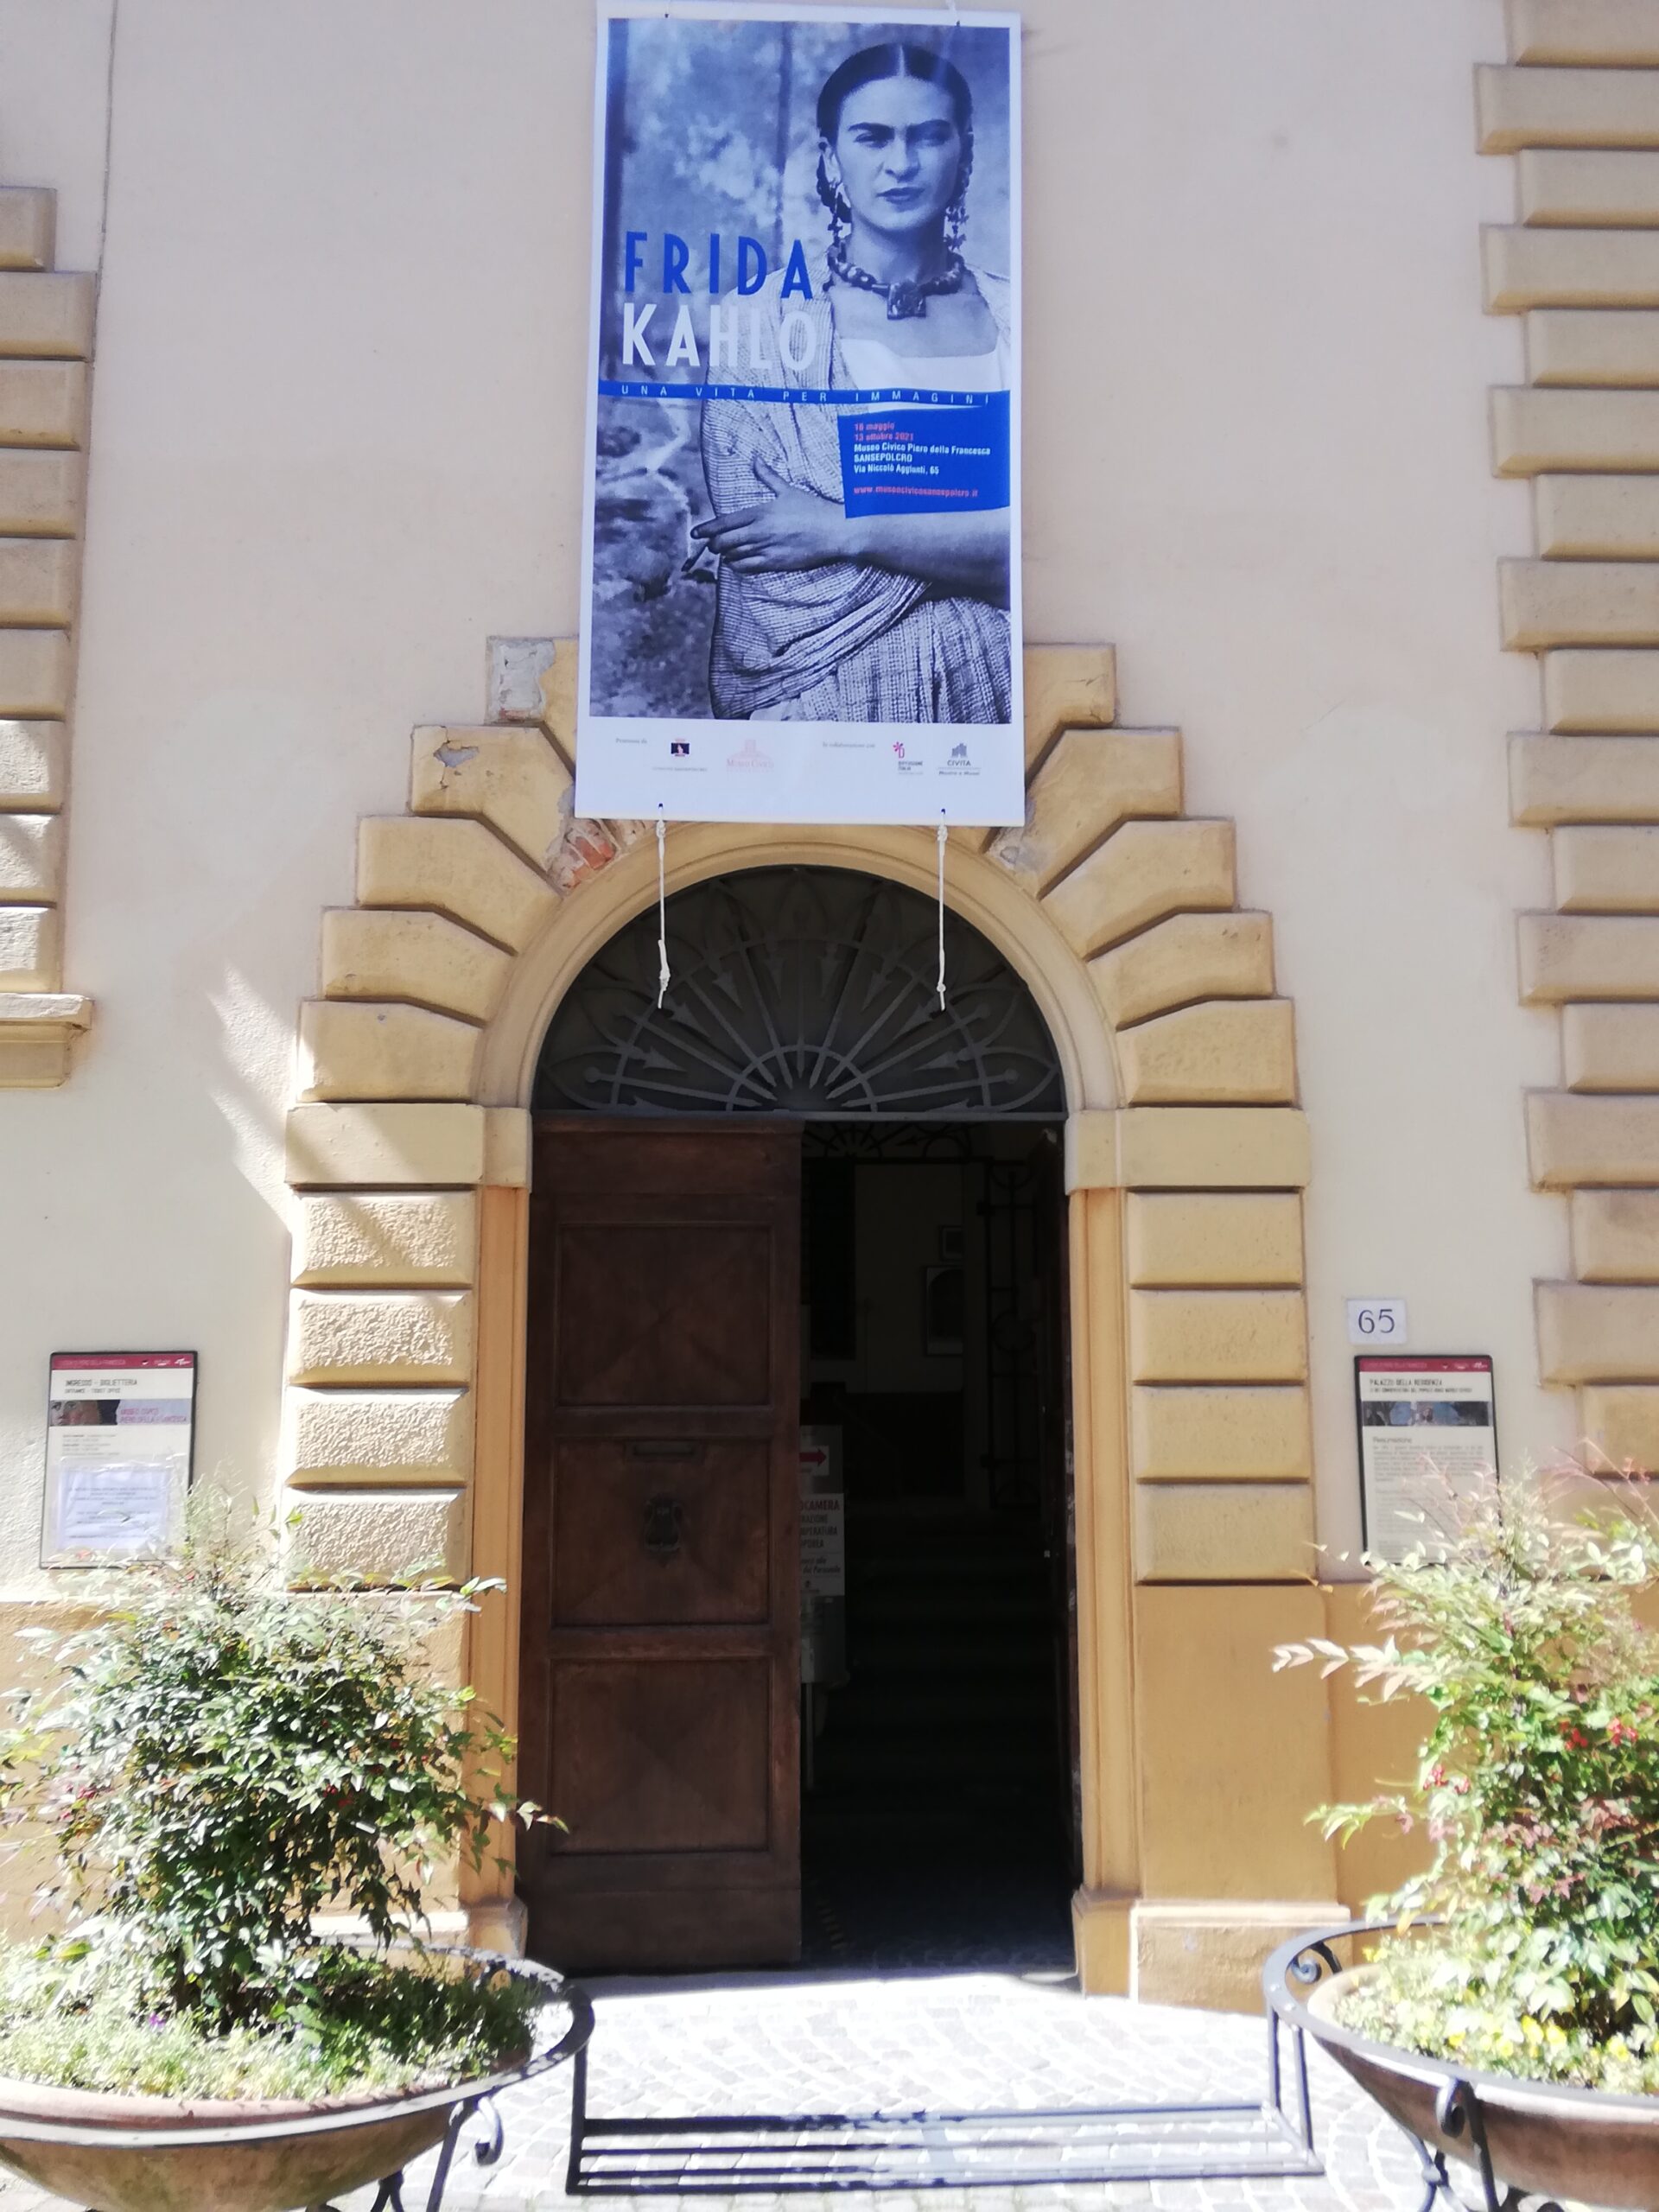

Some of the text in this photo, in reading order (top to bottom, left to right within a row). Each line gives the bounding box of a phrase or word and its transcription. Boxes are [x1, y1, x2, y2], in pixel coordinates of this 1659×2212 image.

[625, 231, 813, 300] FRIDA
[622, 302, 817, 372] KAHLO
[621, 385, 988, 404] UNA VITA PER IMMAGINI
[866, 422, 895, 431] maggio
[866, 433, 893, 442] ottobre
[895, 432, 914, 442] 2021
[854, 442, 991, 455] Museo Civico Piero della Francesca
[854, 454, 913, 462] SANSEPOLCRO
[854, 465, 866, 474] Via
[1358, 1308, 1395, 1334] 65
